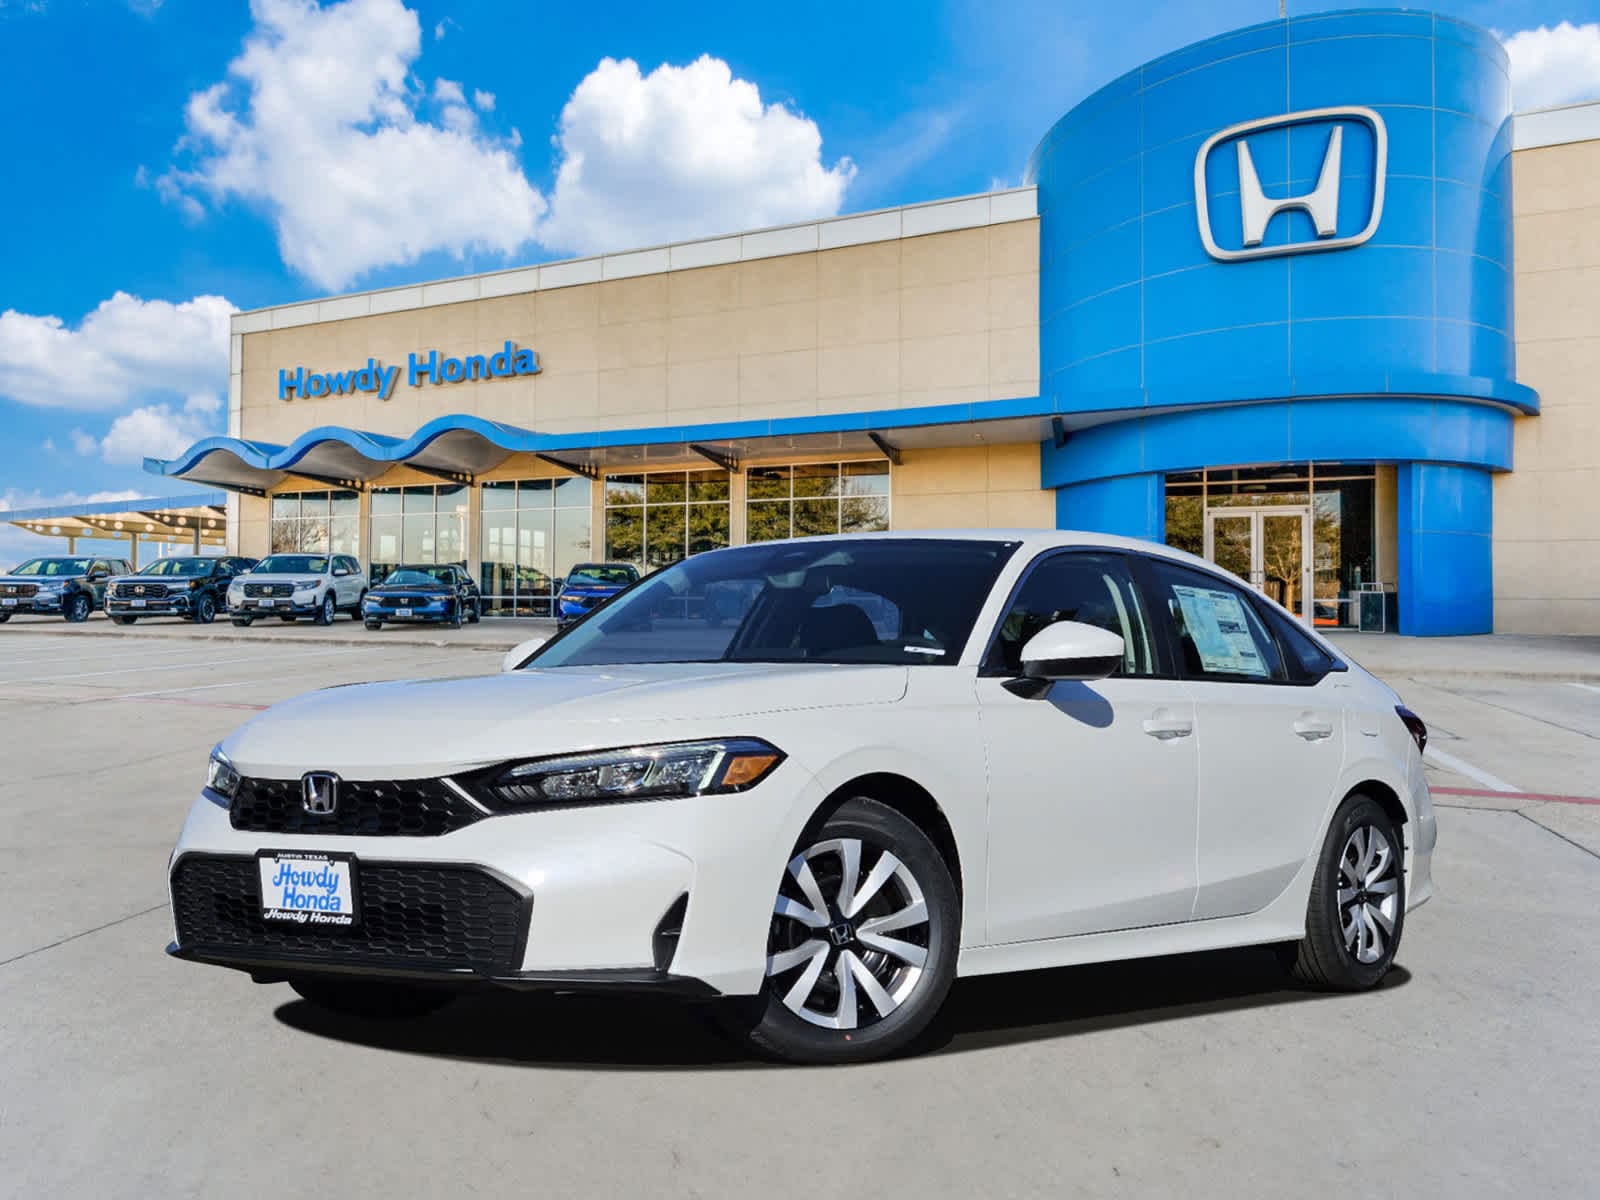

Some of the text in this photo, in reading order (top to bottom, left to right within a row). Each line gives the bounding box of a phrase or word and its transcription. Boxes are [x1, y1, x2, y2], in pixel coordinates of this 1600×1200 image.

[279, 340, 541, 400] Howdy Honda
[272, 863, 340, 895] Howdy
[282, 886, 342, 912] Honda
[263, 908, 353, 925] Howdy Honda
